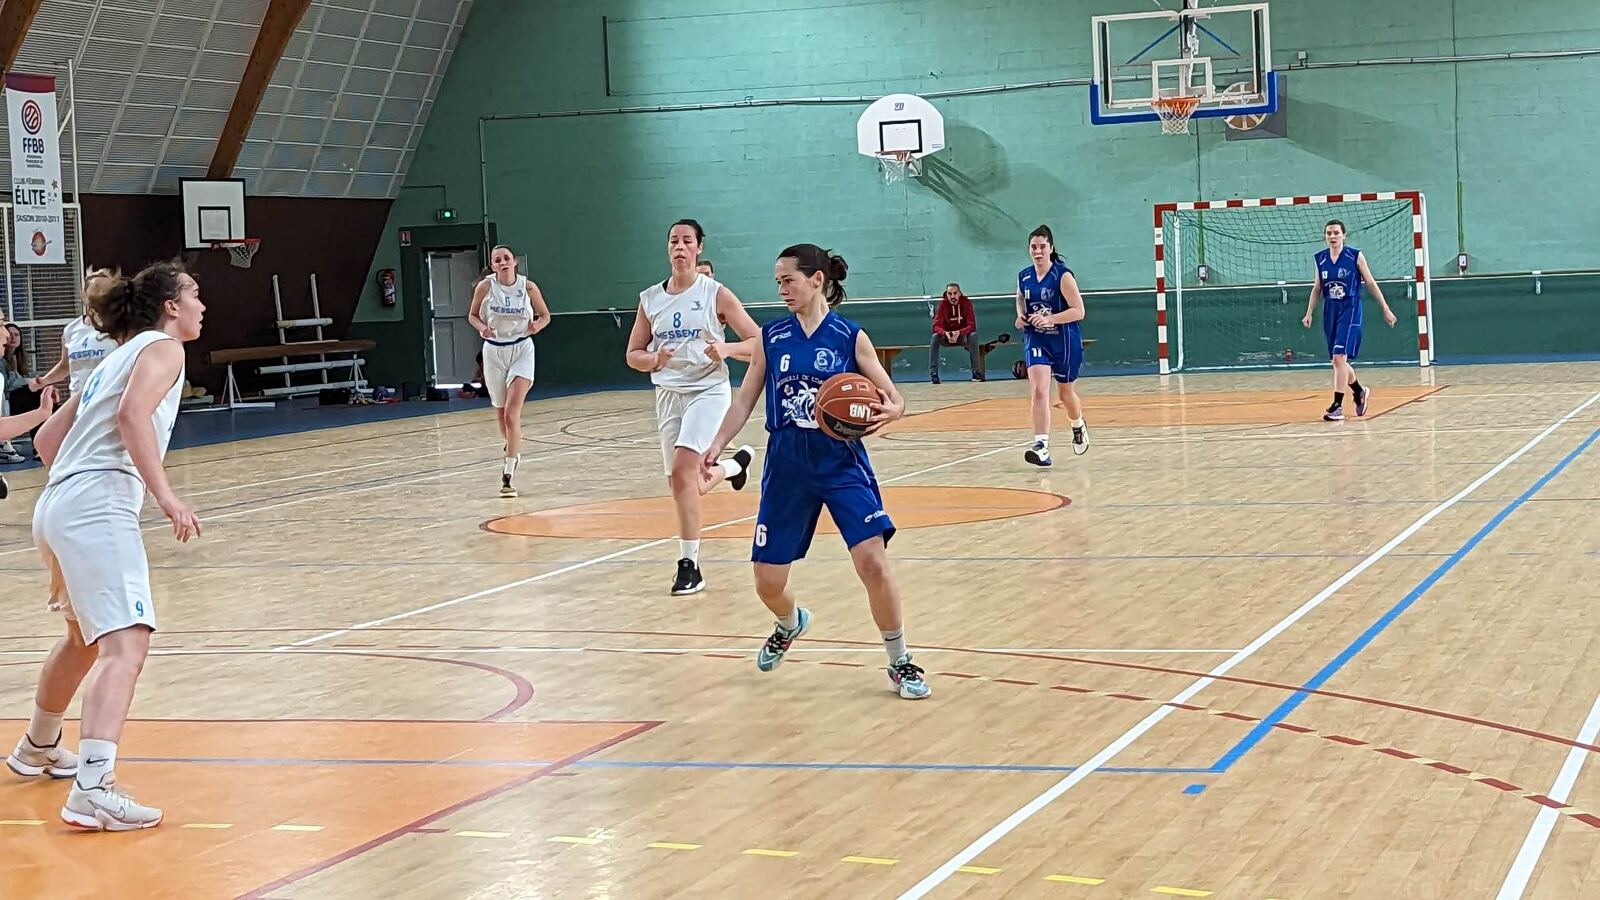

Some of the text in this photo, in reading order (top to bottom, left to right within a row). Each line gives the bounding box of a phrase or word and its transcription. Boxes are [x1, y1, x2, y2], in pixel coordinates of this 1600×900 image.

[23, 138, 45, 153] FFBB
[15, 186, 46, 206] ÉLITE
[673, 312, 681, 328] 8
[1031, 347, 1042, 358] 11
[780, 354, 790, 372] 6
[755, 524, 768, 547] 6
[135, 600, 144, 618] 9
